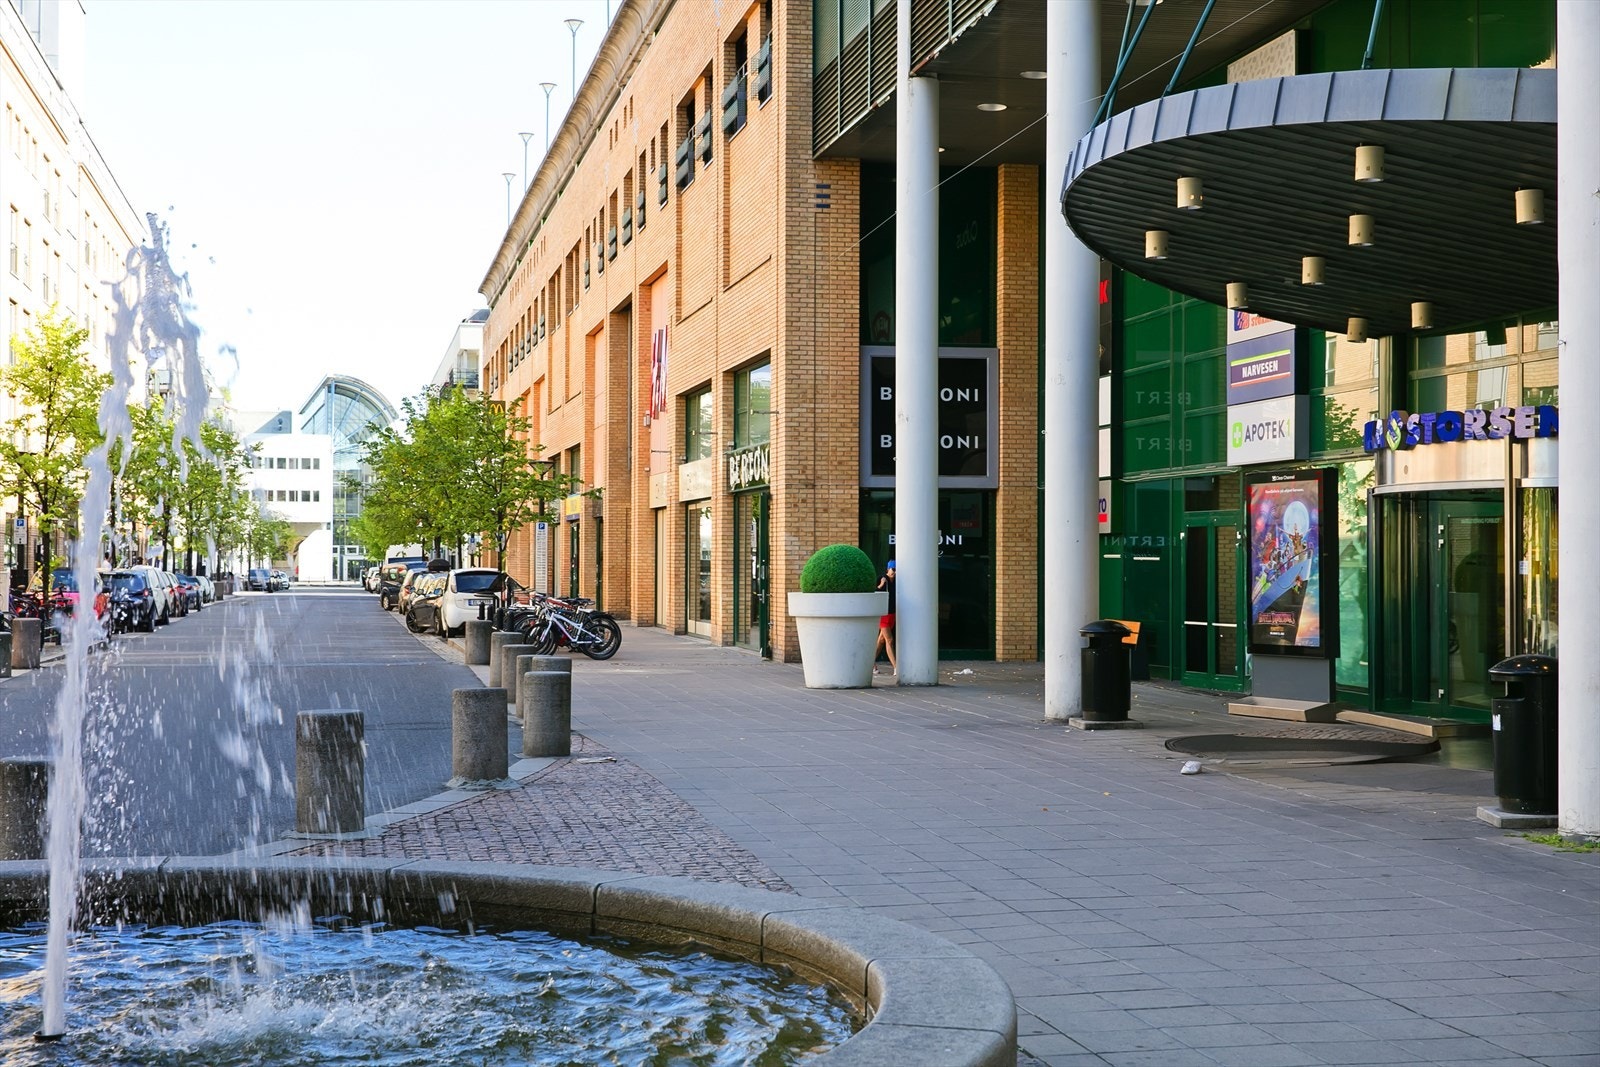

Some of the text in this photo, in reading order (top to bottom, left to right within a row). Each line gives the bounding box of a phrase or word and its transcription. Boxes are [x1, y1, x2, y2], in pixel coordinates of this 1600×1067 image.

[1242, 360, 1279, 378] NARVESEN
[880, 386, 979, 402] BONI
[1244, 418, 1291, 442] APOTEK 1
[1406, 405, 1559, 447] STORSEN
[880, 434, 979, 449] BONI
[729, 446, 769, 489] BERTON
[1098, 497, 1107, 513] ro
[888, 534, 963, 545] BONI
